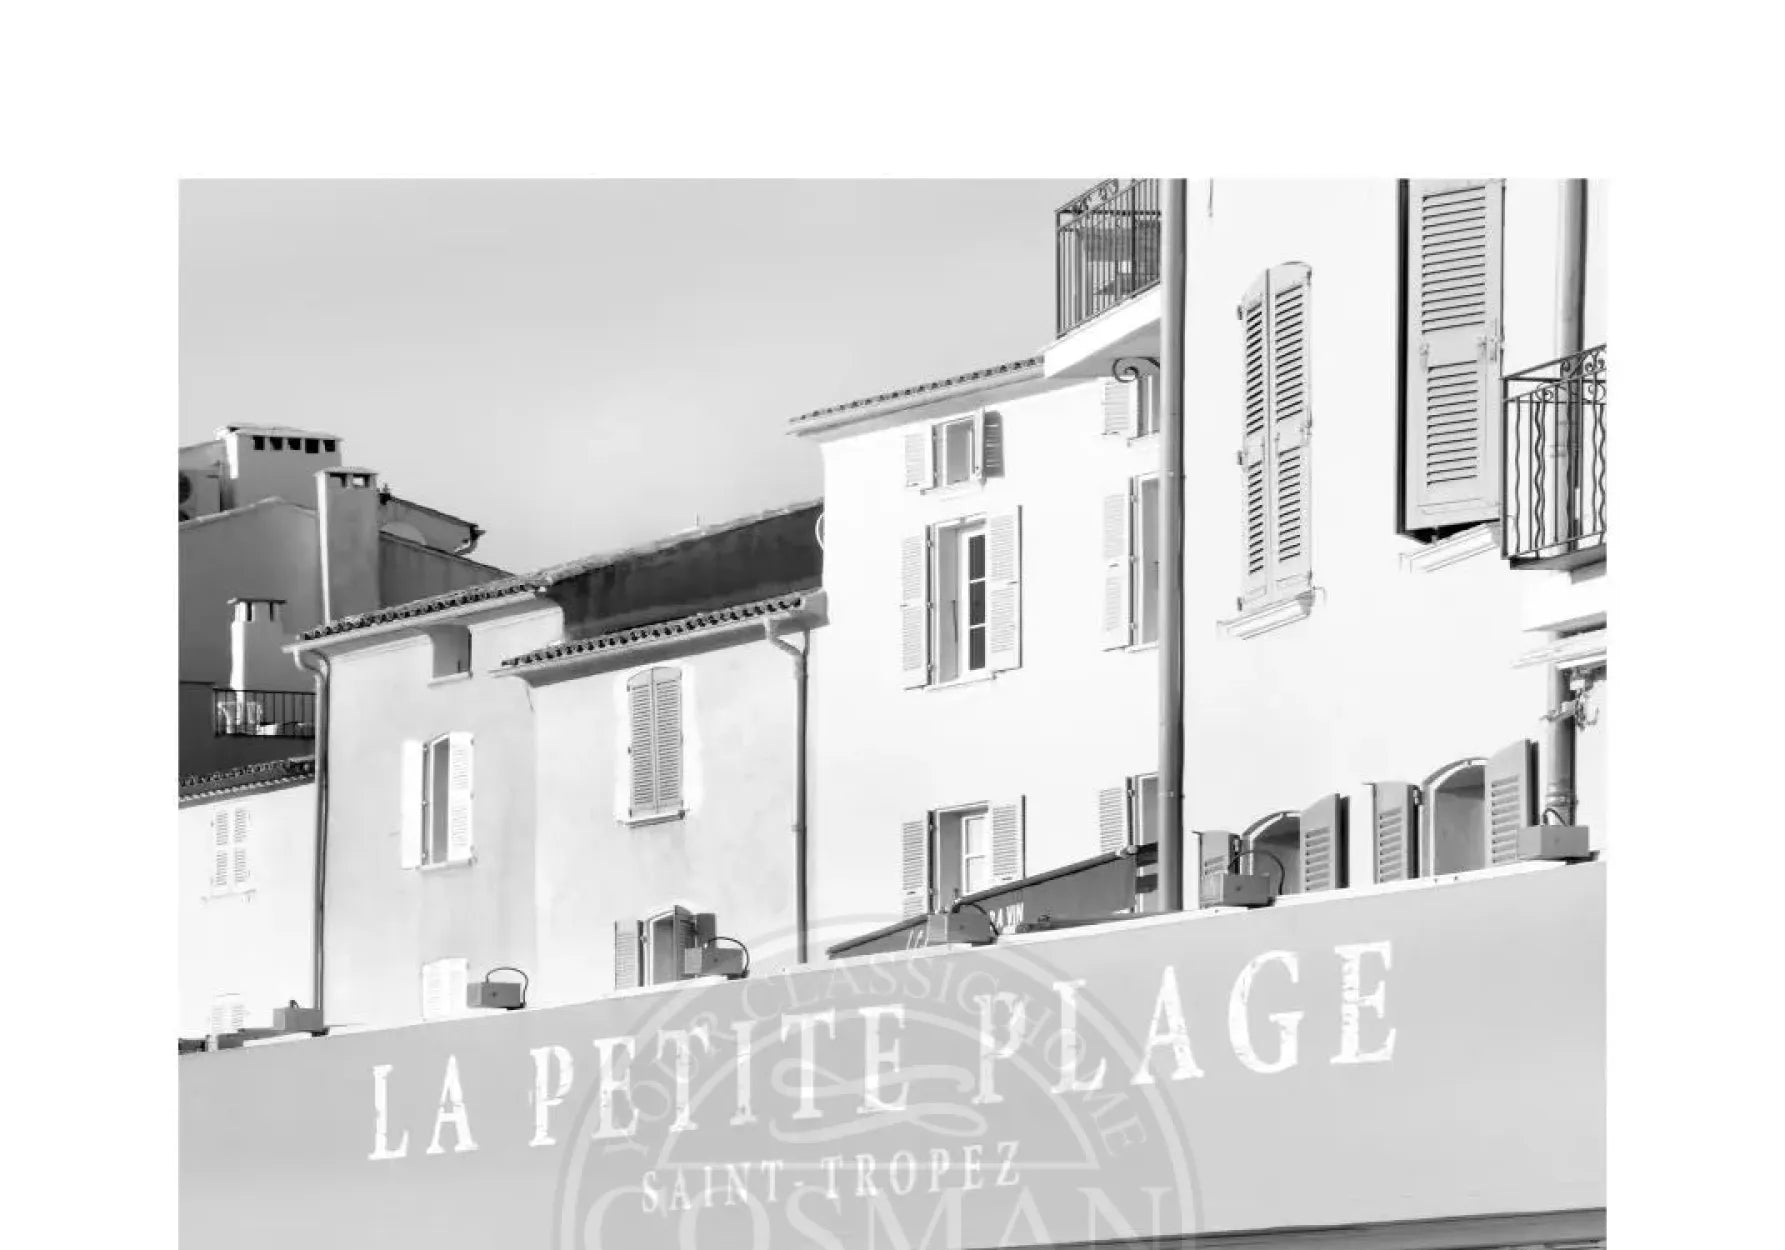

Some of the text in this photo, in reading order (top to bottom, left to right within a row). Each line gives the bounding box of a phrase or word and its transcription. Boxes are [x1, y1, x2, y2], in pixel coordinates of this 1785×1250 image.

[368, 940, 1397, 1161] LA PETITE PLAGE
